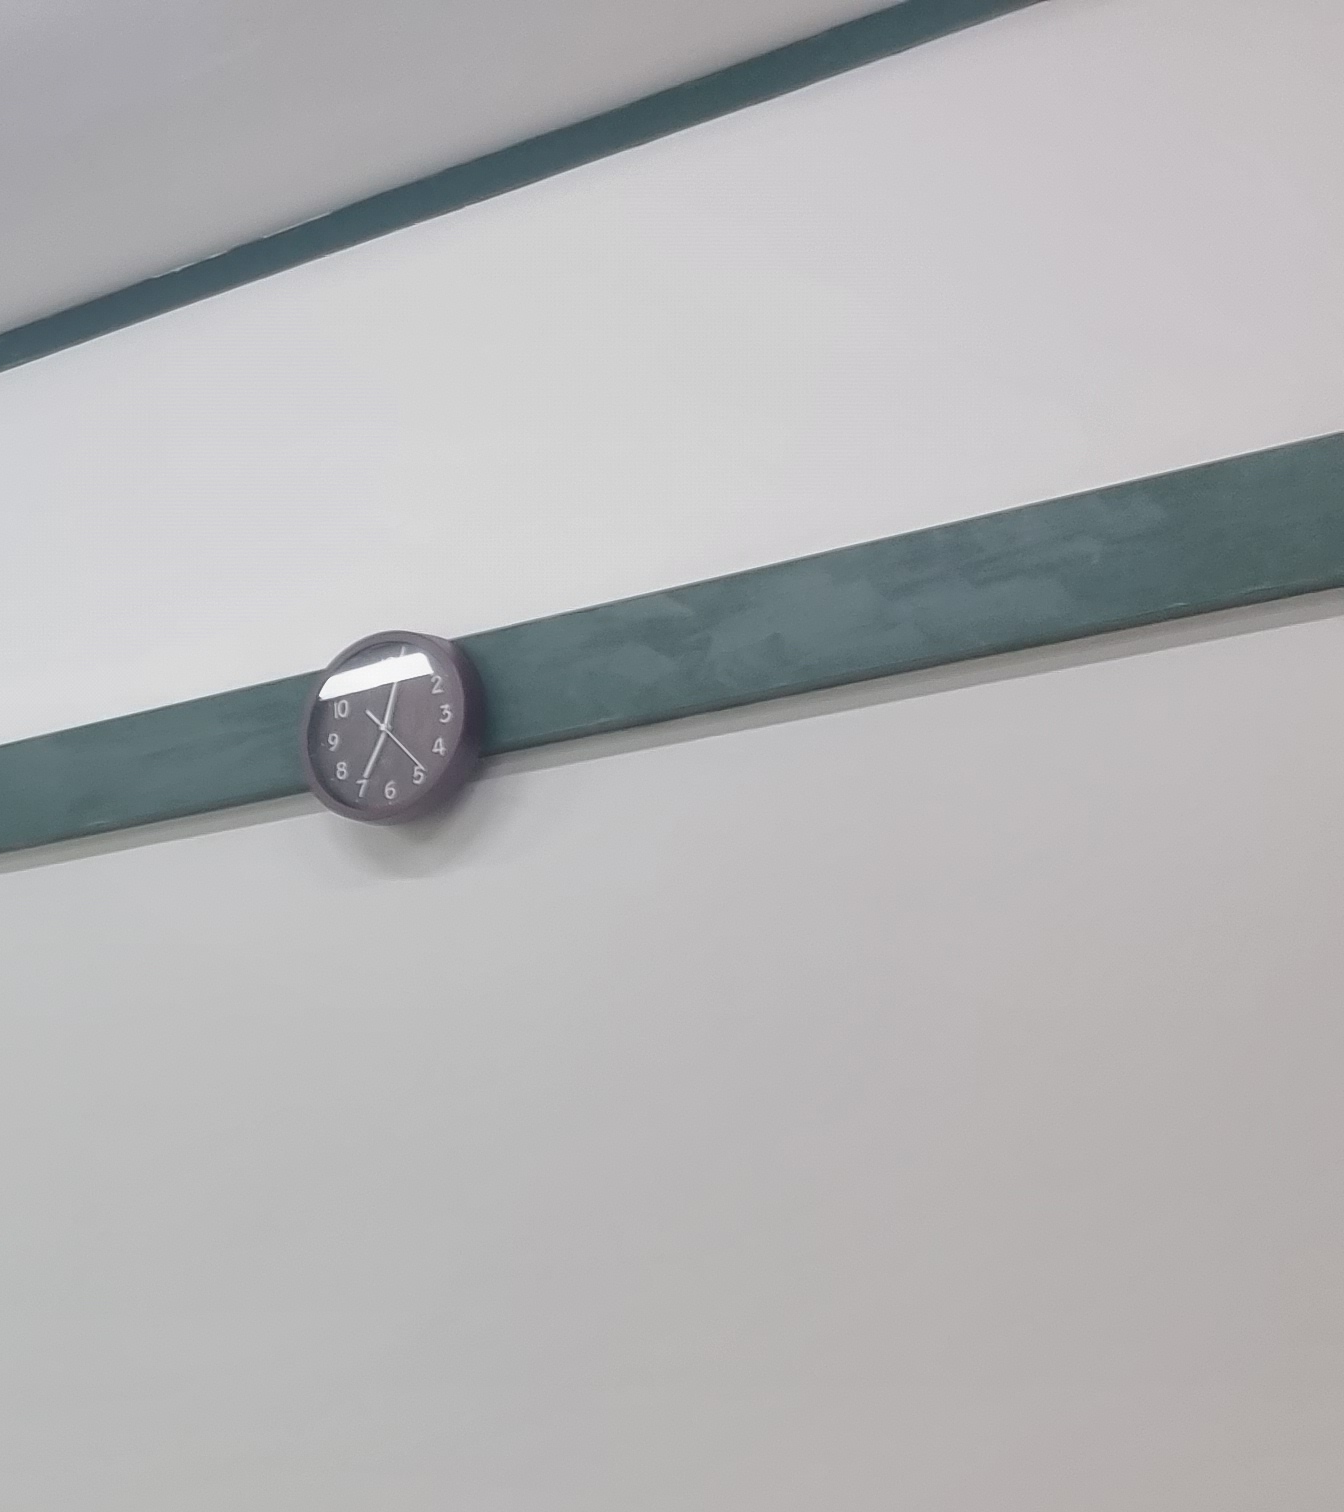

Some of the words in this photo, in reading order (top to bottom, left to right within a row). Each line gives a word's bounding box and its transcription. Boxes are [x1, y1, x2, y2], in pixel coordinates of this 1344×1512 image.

[430, 675, 444, 695] 2
[333, 699, 349, 719] 10
[439, 704, 453, 723] 3
[327, 733, 340, 752] 9
[432, 737, 446, 756] 4
[336, 761, 349, 781] 8
[412, 766, 425, 785] 5
[356, 778, 369, 798] 7
[384, 780, 397, 799] 6
